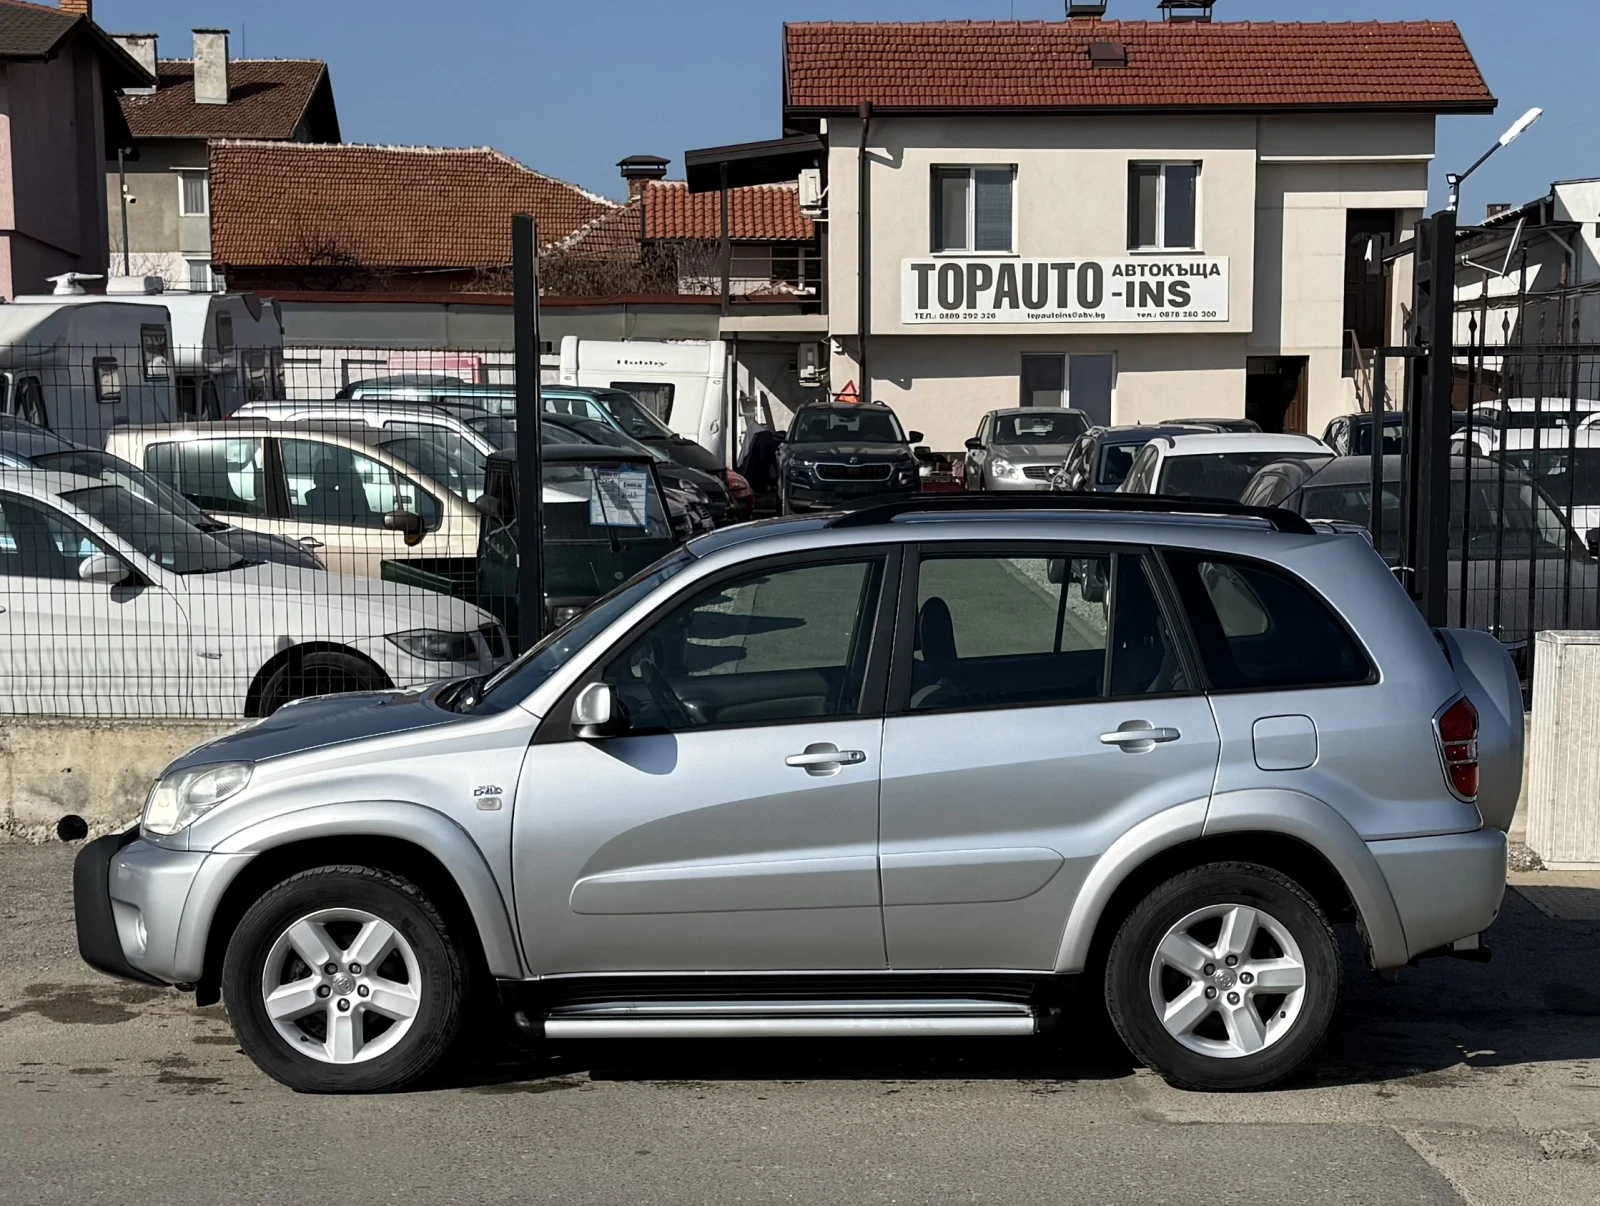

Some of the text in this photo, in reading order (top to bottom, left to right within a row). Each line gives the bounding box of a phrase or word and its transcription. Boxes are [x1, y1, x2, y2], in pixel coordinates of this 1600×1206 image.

[1111, 263, 1221, 279] АВТОКЪЩА
[910, 262, 1192, 310] TOPAUTO -INS
[616, 359, 668, 368] Hobby
